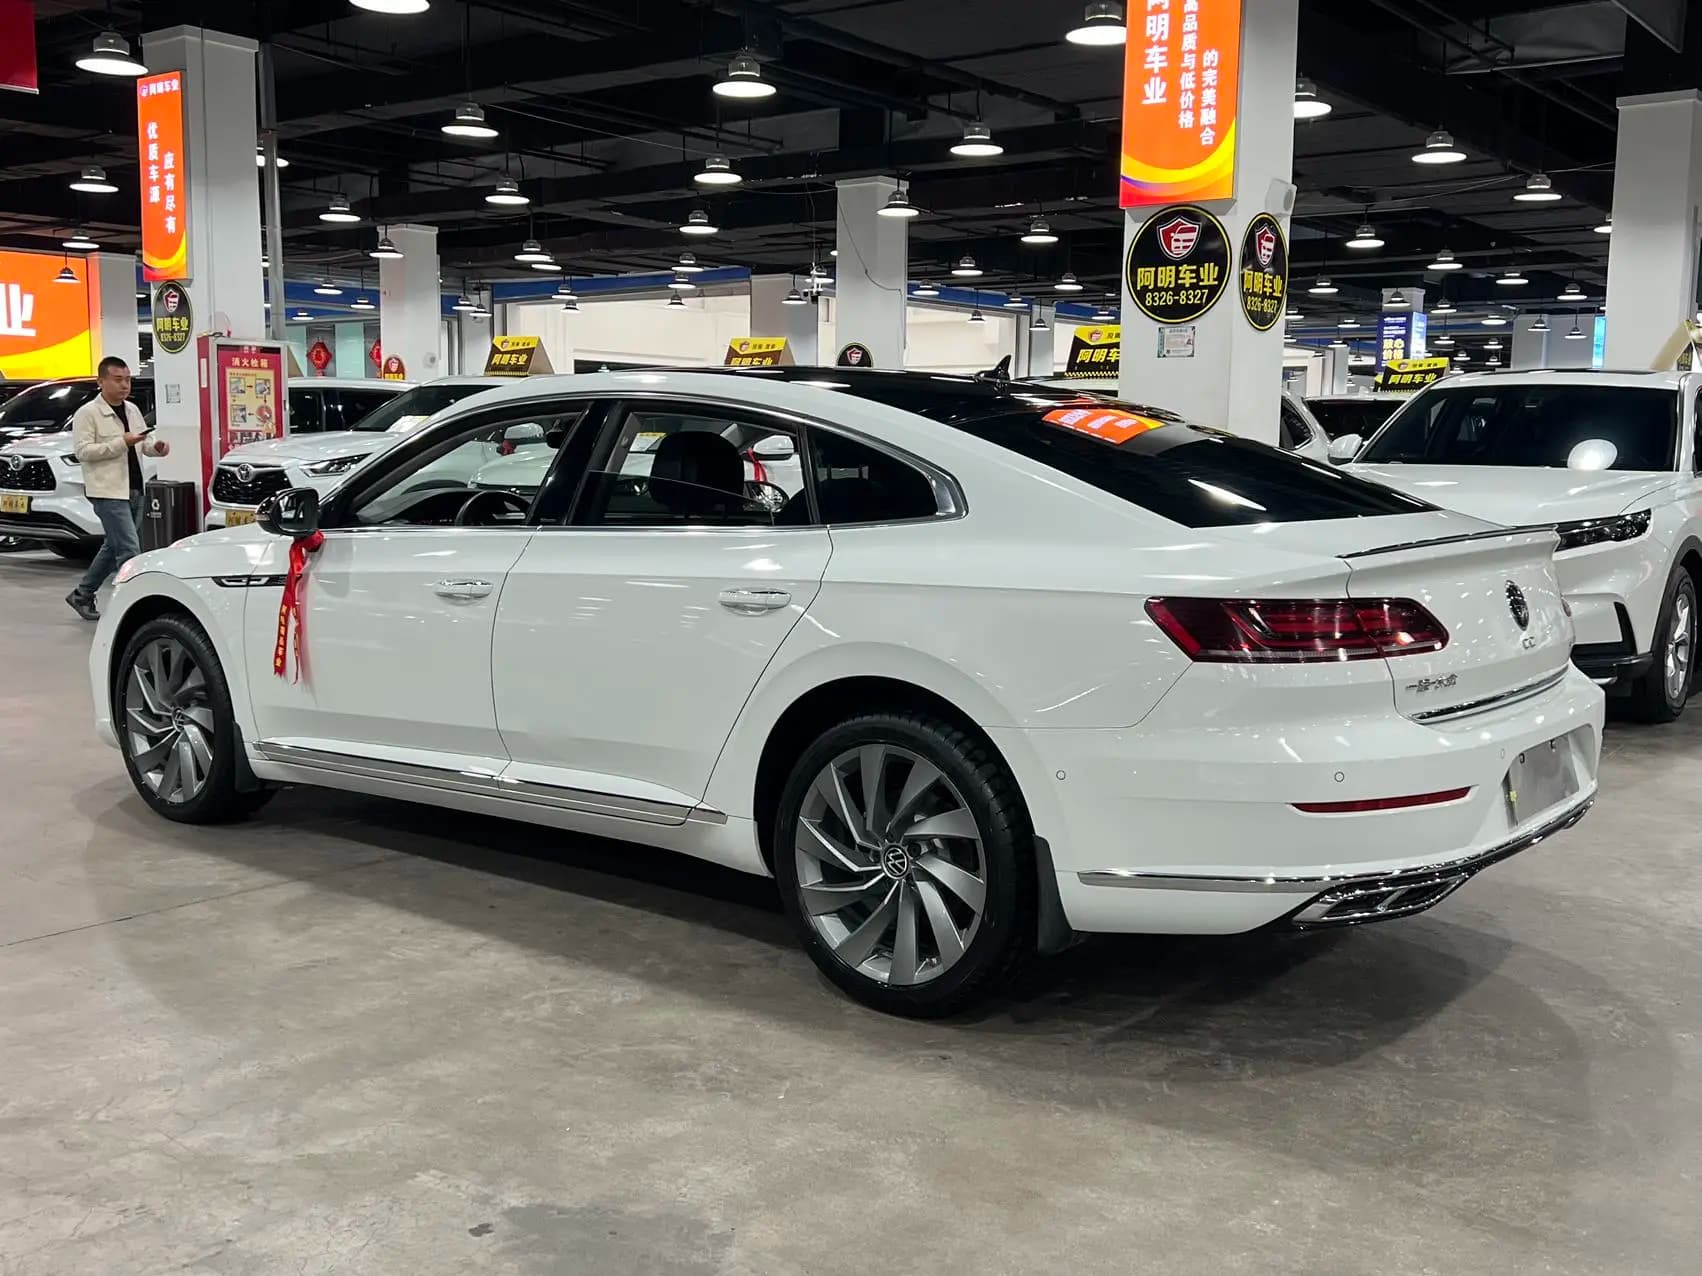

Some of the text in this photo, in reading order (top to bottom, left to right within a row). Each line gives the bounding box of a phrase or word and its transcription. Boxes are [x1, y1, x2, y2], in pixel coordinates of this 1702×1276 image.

[149, 79, 179, 96] 阿明车业
[1200, 48, 1219, 145] 的完美融合
[147, 121, 160, 203] 优质车源
[163, 151, 176, 233] 应有尽有
[1136, 263, 1219, 290] 阿明车业
[1243, 270, 1283, 297] 阿明车业
[1145, 289, 1208, 306] 8326-8327
[156, 317, 189, 332] 阿明车业
[231, 357, 269, 369] 消火栓箱
[490, 353, 528, 365] 阿明车业
[1388, 372, 1437, 385] 阿明车业
